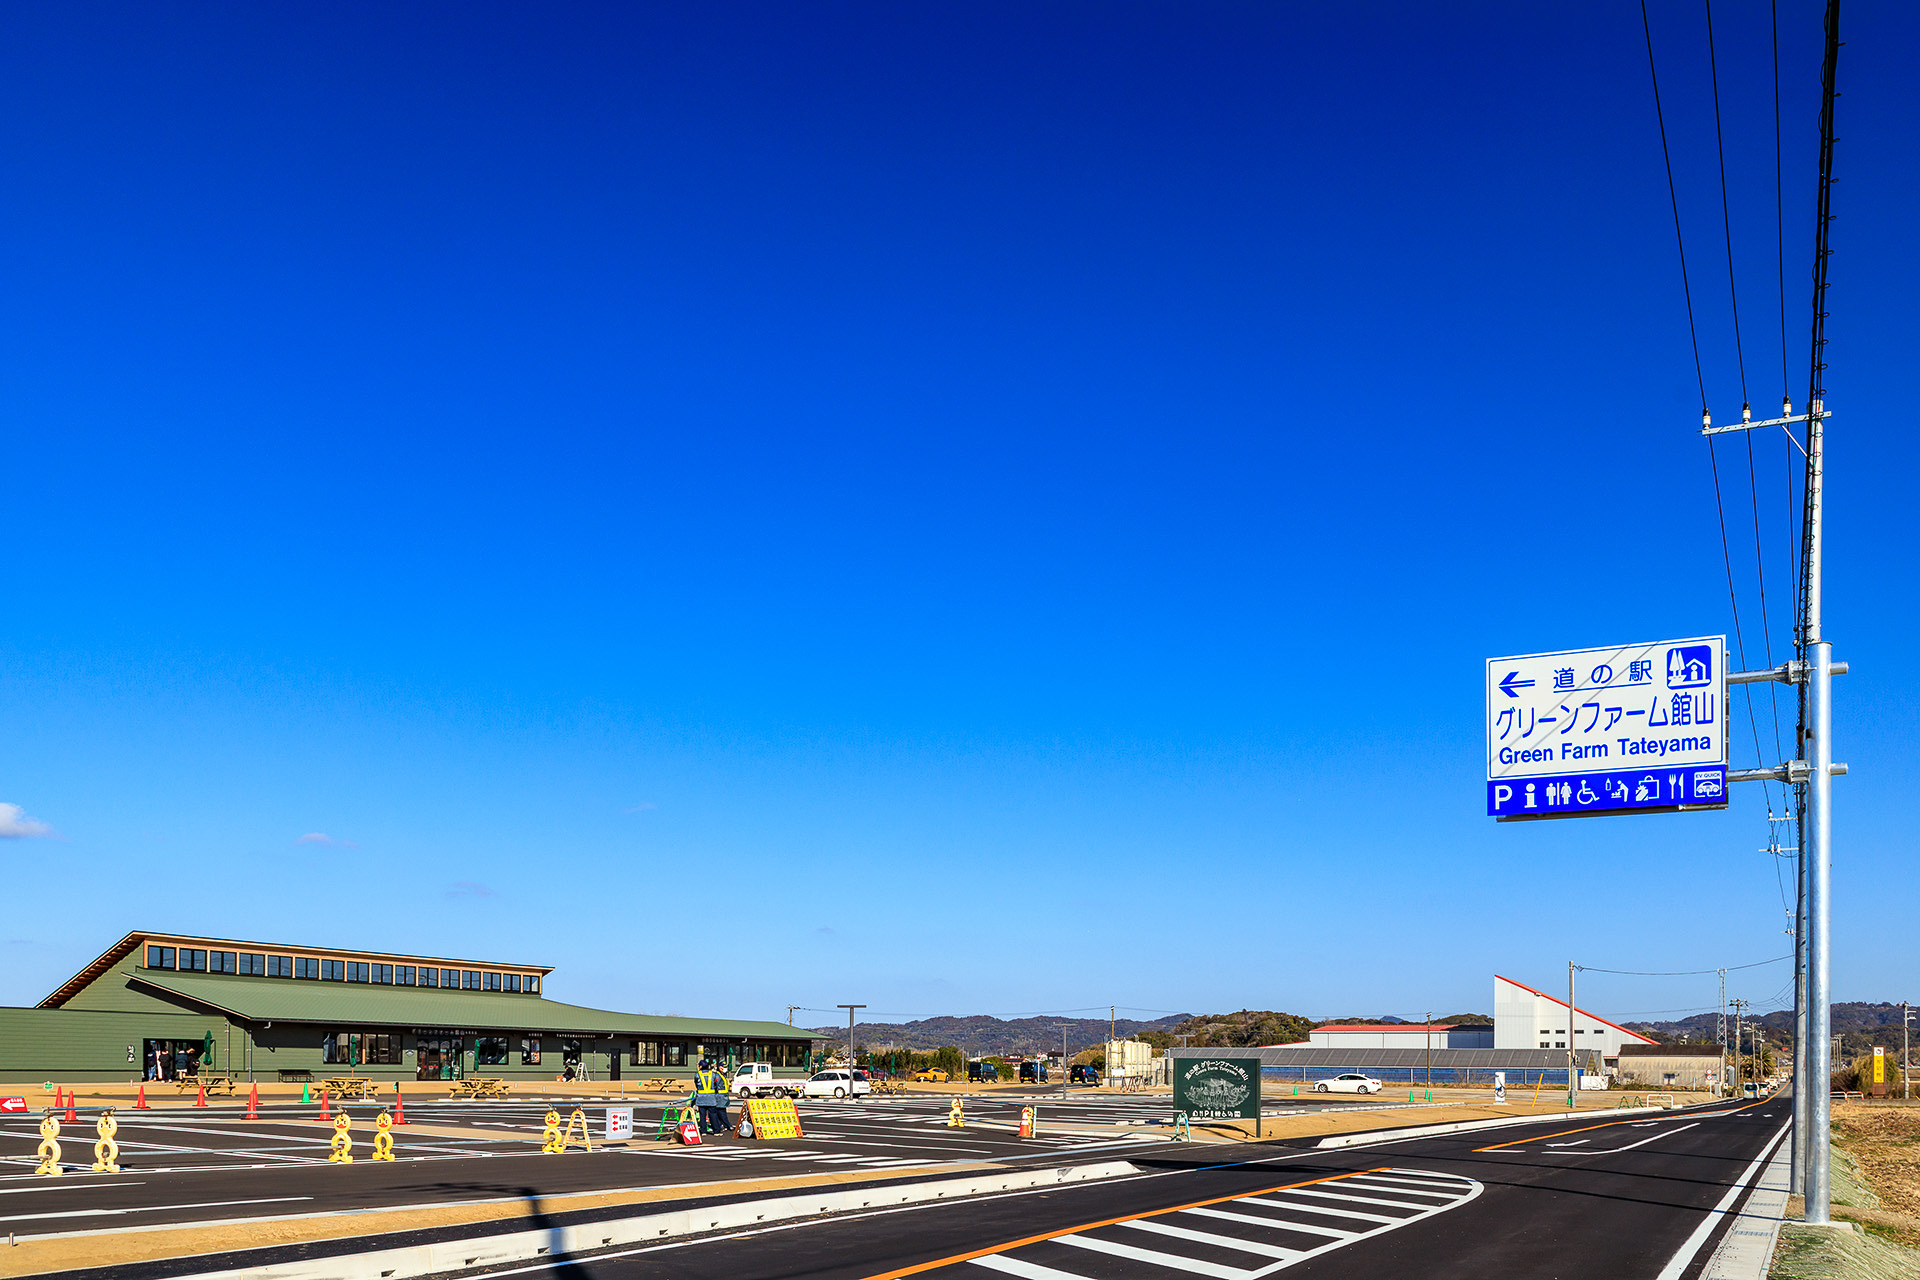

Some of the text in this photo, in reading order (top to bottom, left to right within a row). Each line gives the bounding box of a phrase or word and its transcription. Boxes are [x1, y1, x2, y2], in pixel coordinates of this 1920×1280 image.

[1553, 660, 1652, 689] 道の駅
[1496, 691, 1714, 740] グリーンファーム館山
[1499, 735, 1711, 765] Green Farm Tateyama
[763, 1128, 795, 1137] プレオープン
